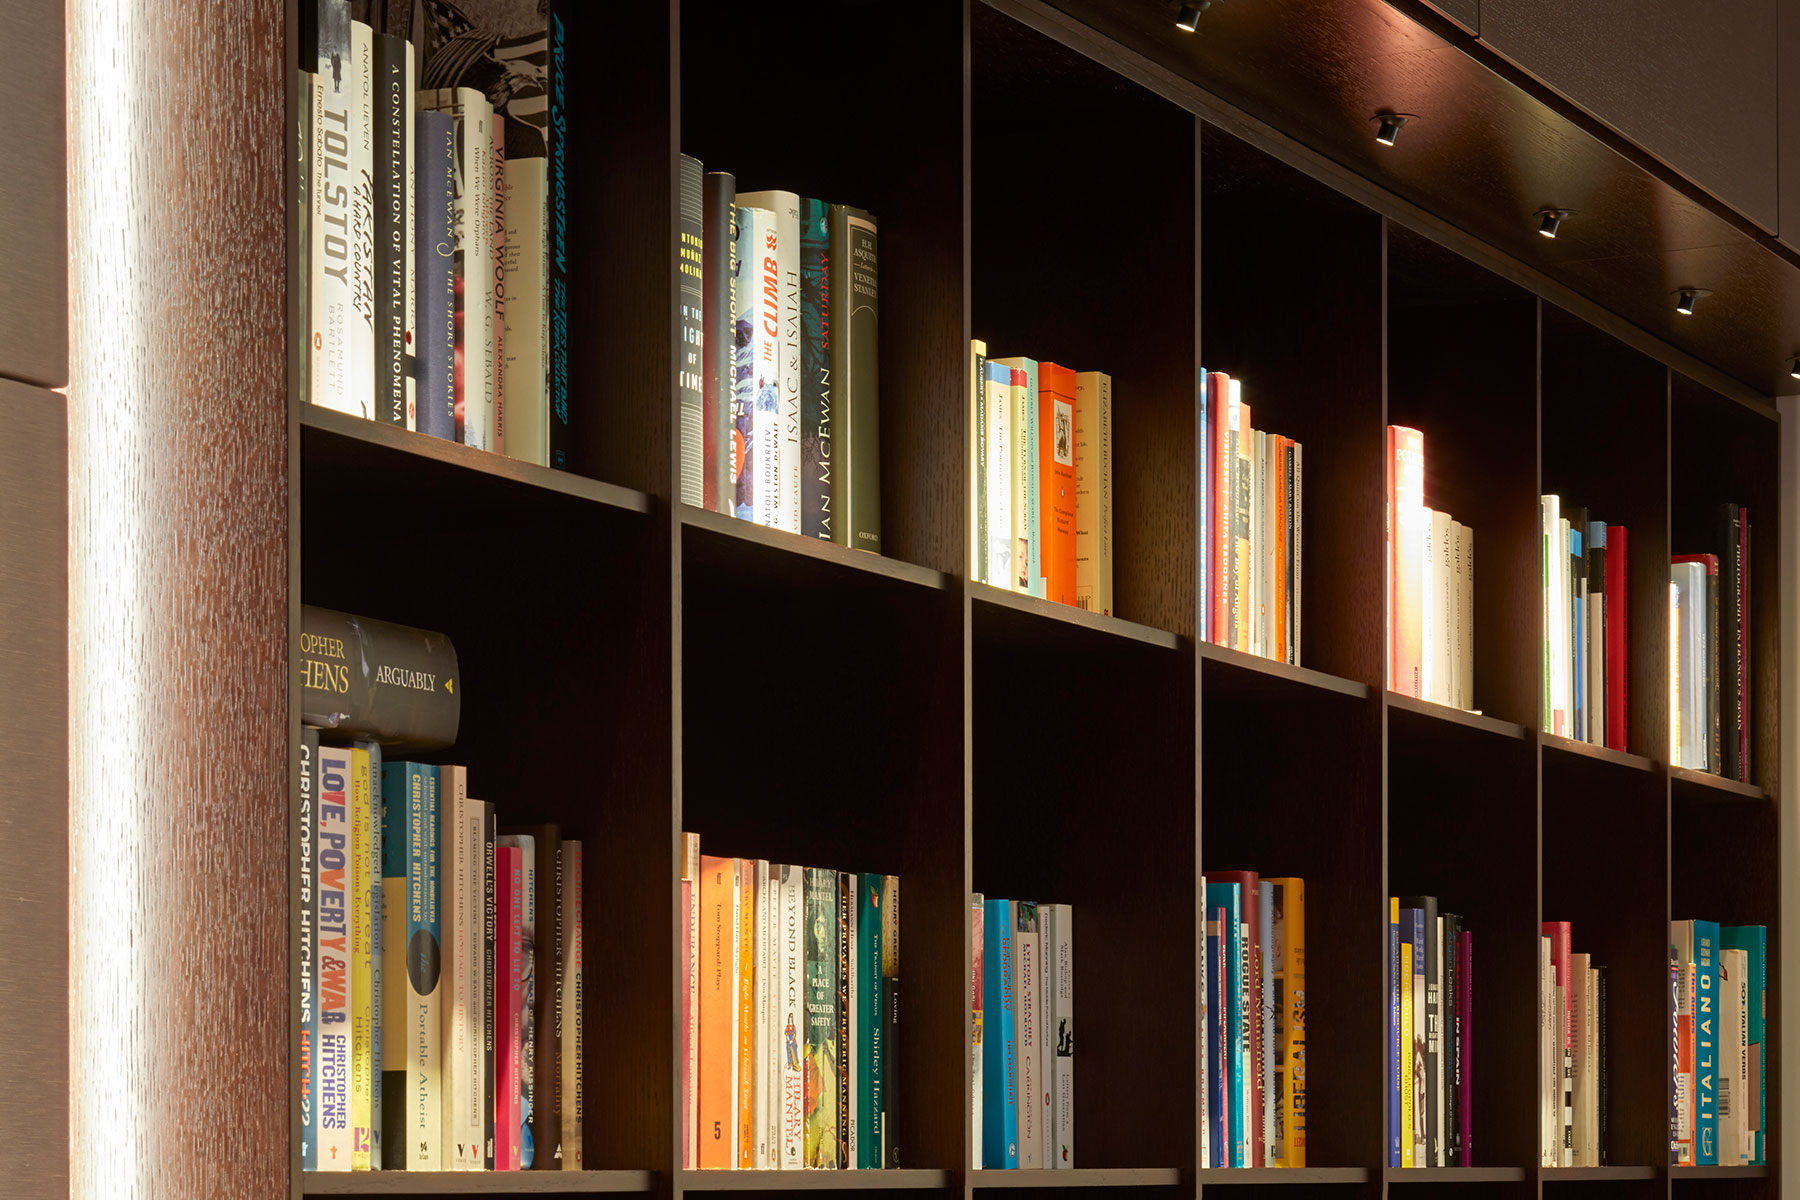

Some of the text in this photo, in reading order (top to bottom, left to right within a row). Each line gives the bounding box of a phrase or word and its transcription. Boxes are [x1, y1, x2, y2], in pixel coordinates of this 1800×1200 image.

[553, 12, 567, 274] BRUCE SPRINGSTEEN
[324, 109, 348, 287] TOLSTOY
[353, 185, 362, 312] A HARD COUNTRY
[392, 64, 402, 422] A CONSTELLATION OF VITAL PHENOMENA
[495, 146, 504, 321] VIRGINIA WOOLF
[336, 303, 344, 396] ROSAMUND
[763, 256, 778, 362] THE CLIMB
[787, 272, 798, 348] ISAIAH
[820, 254, 829, 349] SATURDAY
[688, 352, 697, 365] OF
[787, 377, 798, 443] ISAAC
[818, 495, 830, 541] IAN
[1222, 504, 1230, 539] ANITA
[1222, 544, 1230, 604] BROOKNER
[376, 665, 436, 692] ARGUABLY
[320, 758, 346, 828] LOVE,
[320, 831, 346, 953] POVERTY
[354, 780, 362, 954] How Religion Poisons Everything
[413, 774, 421, 922] CHRISTOPHER HITCHENS
[301, 910, 312, 1023] HITCHENS
[788, 885, 796, 1007] BEYOND BLACK
[842, 984, 847, 1002] WE
[1241, 936, 1251, 1053] ROGUE STATE
[419, 1004, 428, 1129] Portable Atheist
[872, 1028, 880, 1075] Shirley
[1254, 944, 1263, 1091] Lord Mansfield
[1701, 974, 1712, 1119] ITALIANO
[322, 1034, 336, 1129] HITCHENS
[336, 1034, 346, 1130] CHRISTOPHER
[785, 1076, 793, 1148] MANTEL
